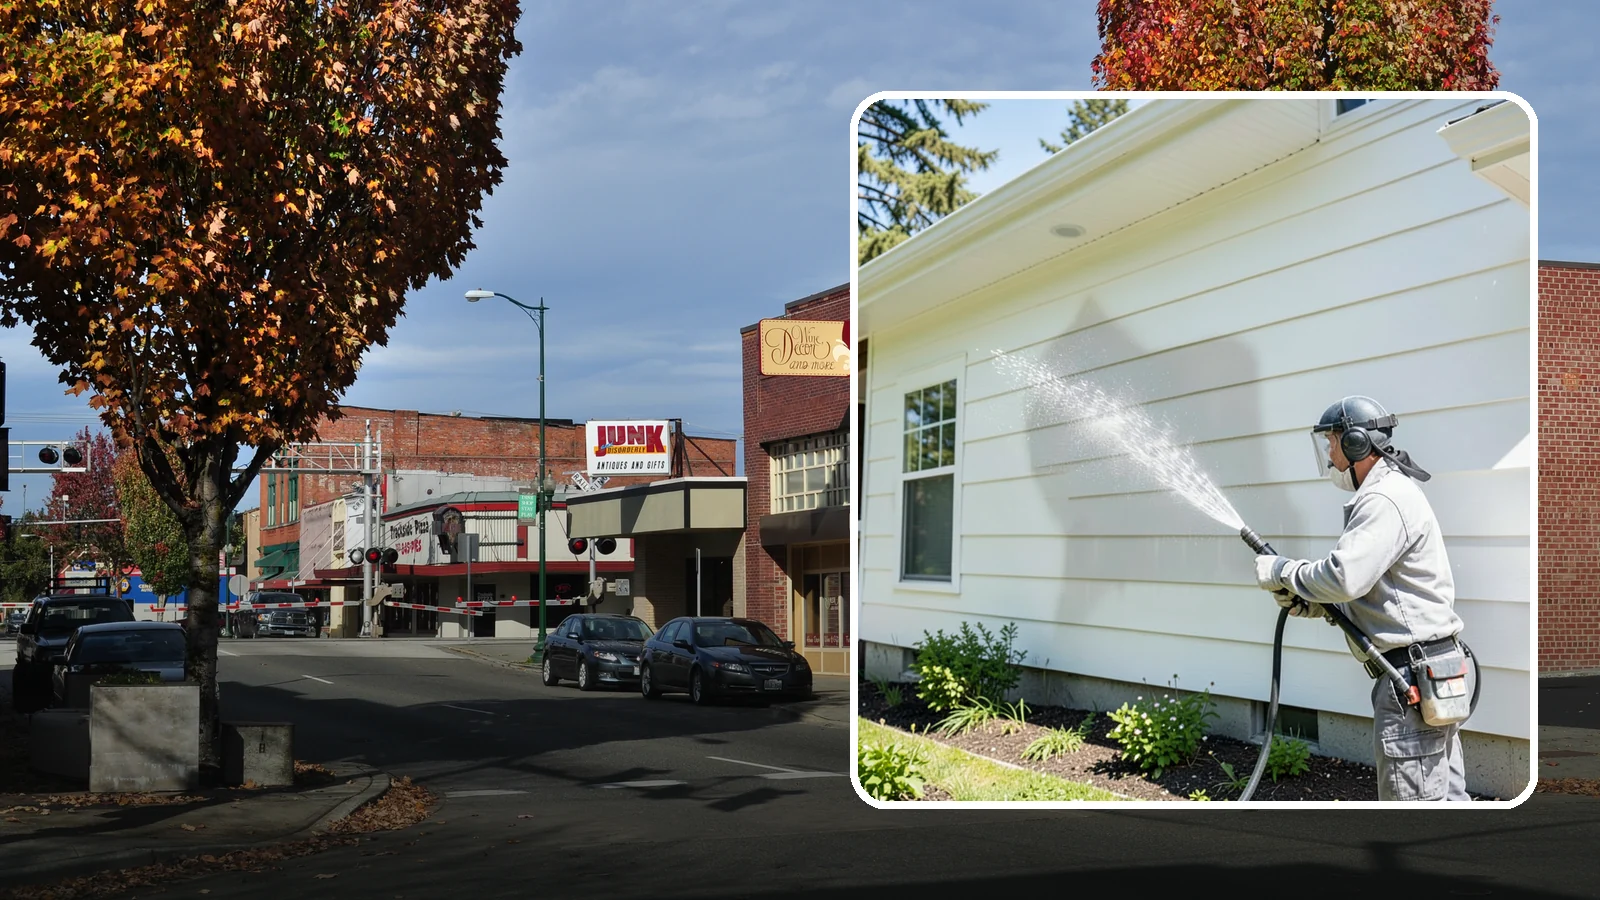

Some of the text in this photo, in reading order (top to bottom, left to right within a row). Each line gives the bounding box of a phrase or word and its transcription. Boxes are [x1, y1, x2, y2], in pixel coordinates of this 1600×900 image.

[595, 425, 666, 457] JUNK
[597, 460, 665, 470] ANTIQUES AND GIFTS
[390, 519, 429, 539] Trackside Pizza
